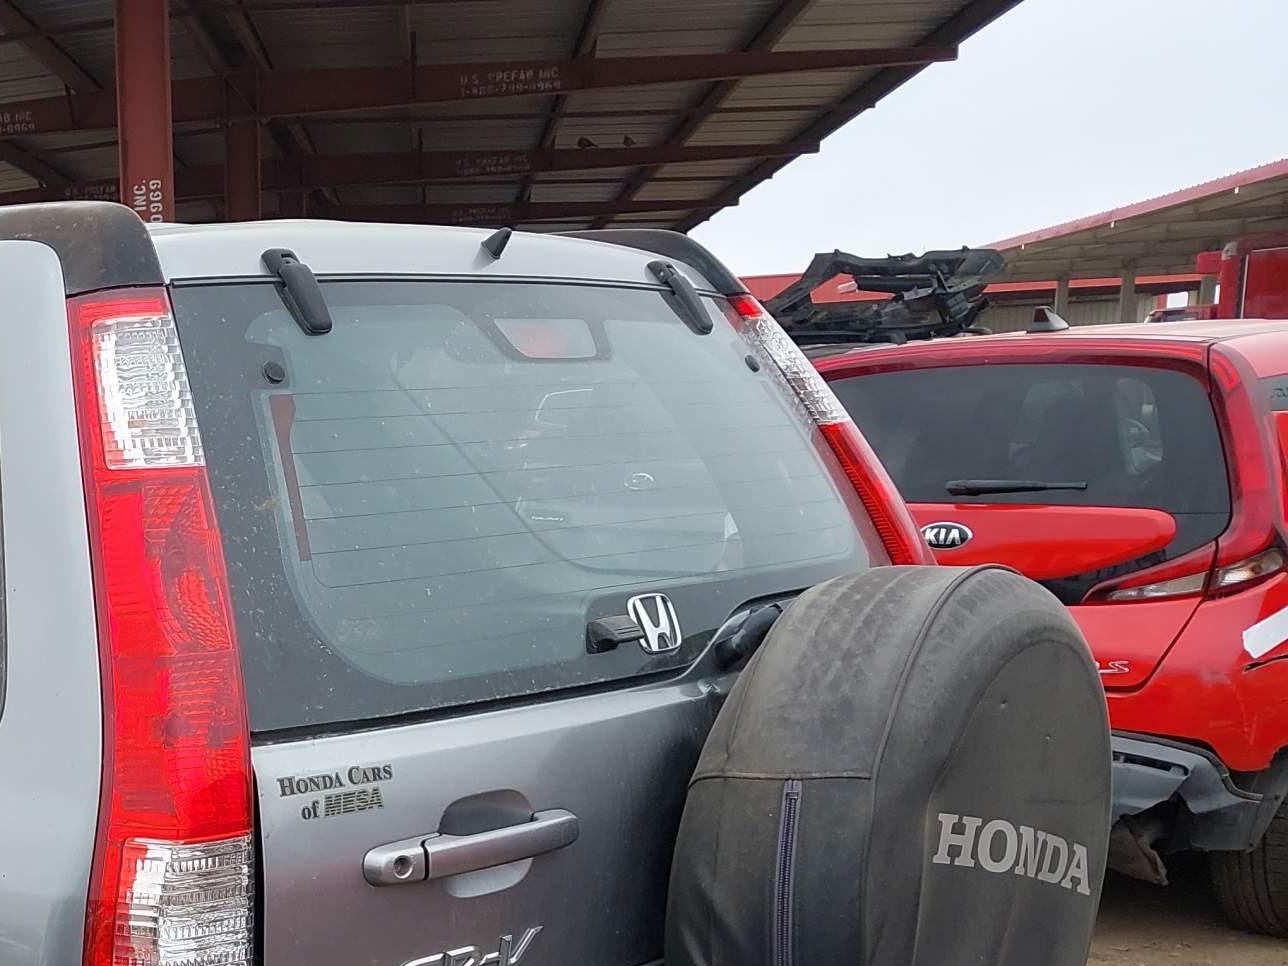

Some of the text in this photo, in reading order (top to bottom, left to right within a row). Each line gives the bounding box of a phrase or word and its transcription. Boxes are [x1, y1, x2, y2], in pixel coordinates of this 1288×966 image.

[276, 763, 393, 798] HONDA CARS
[300, 787, 384, 820] of MESA
[932, 813, 1092, 896] HONDA
